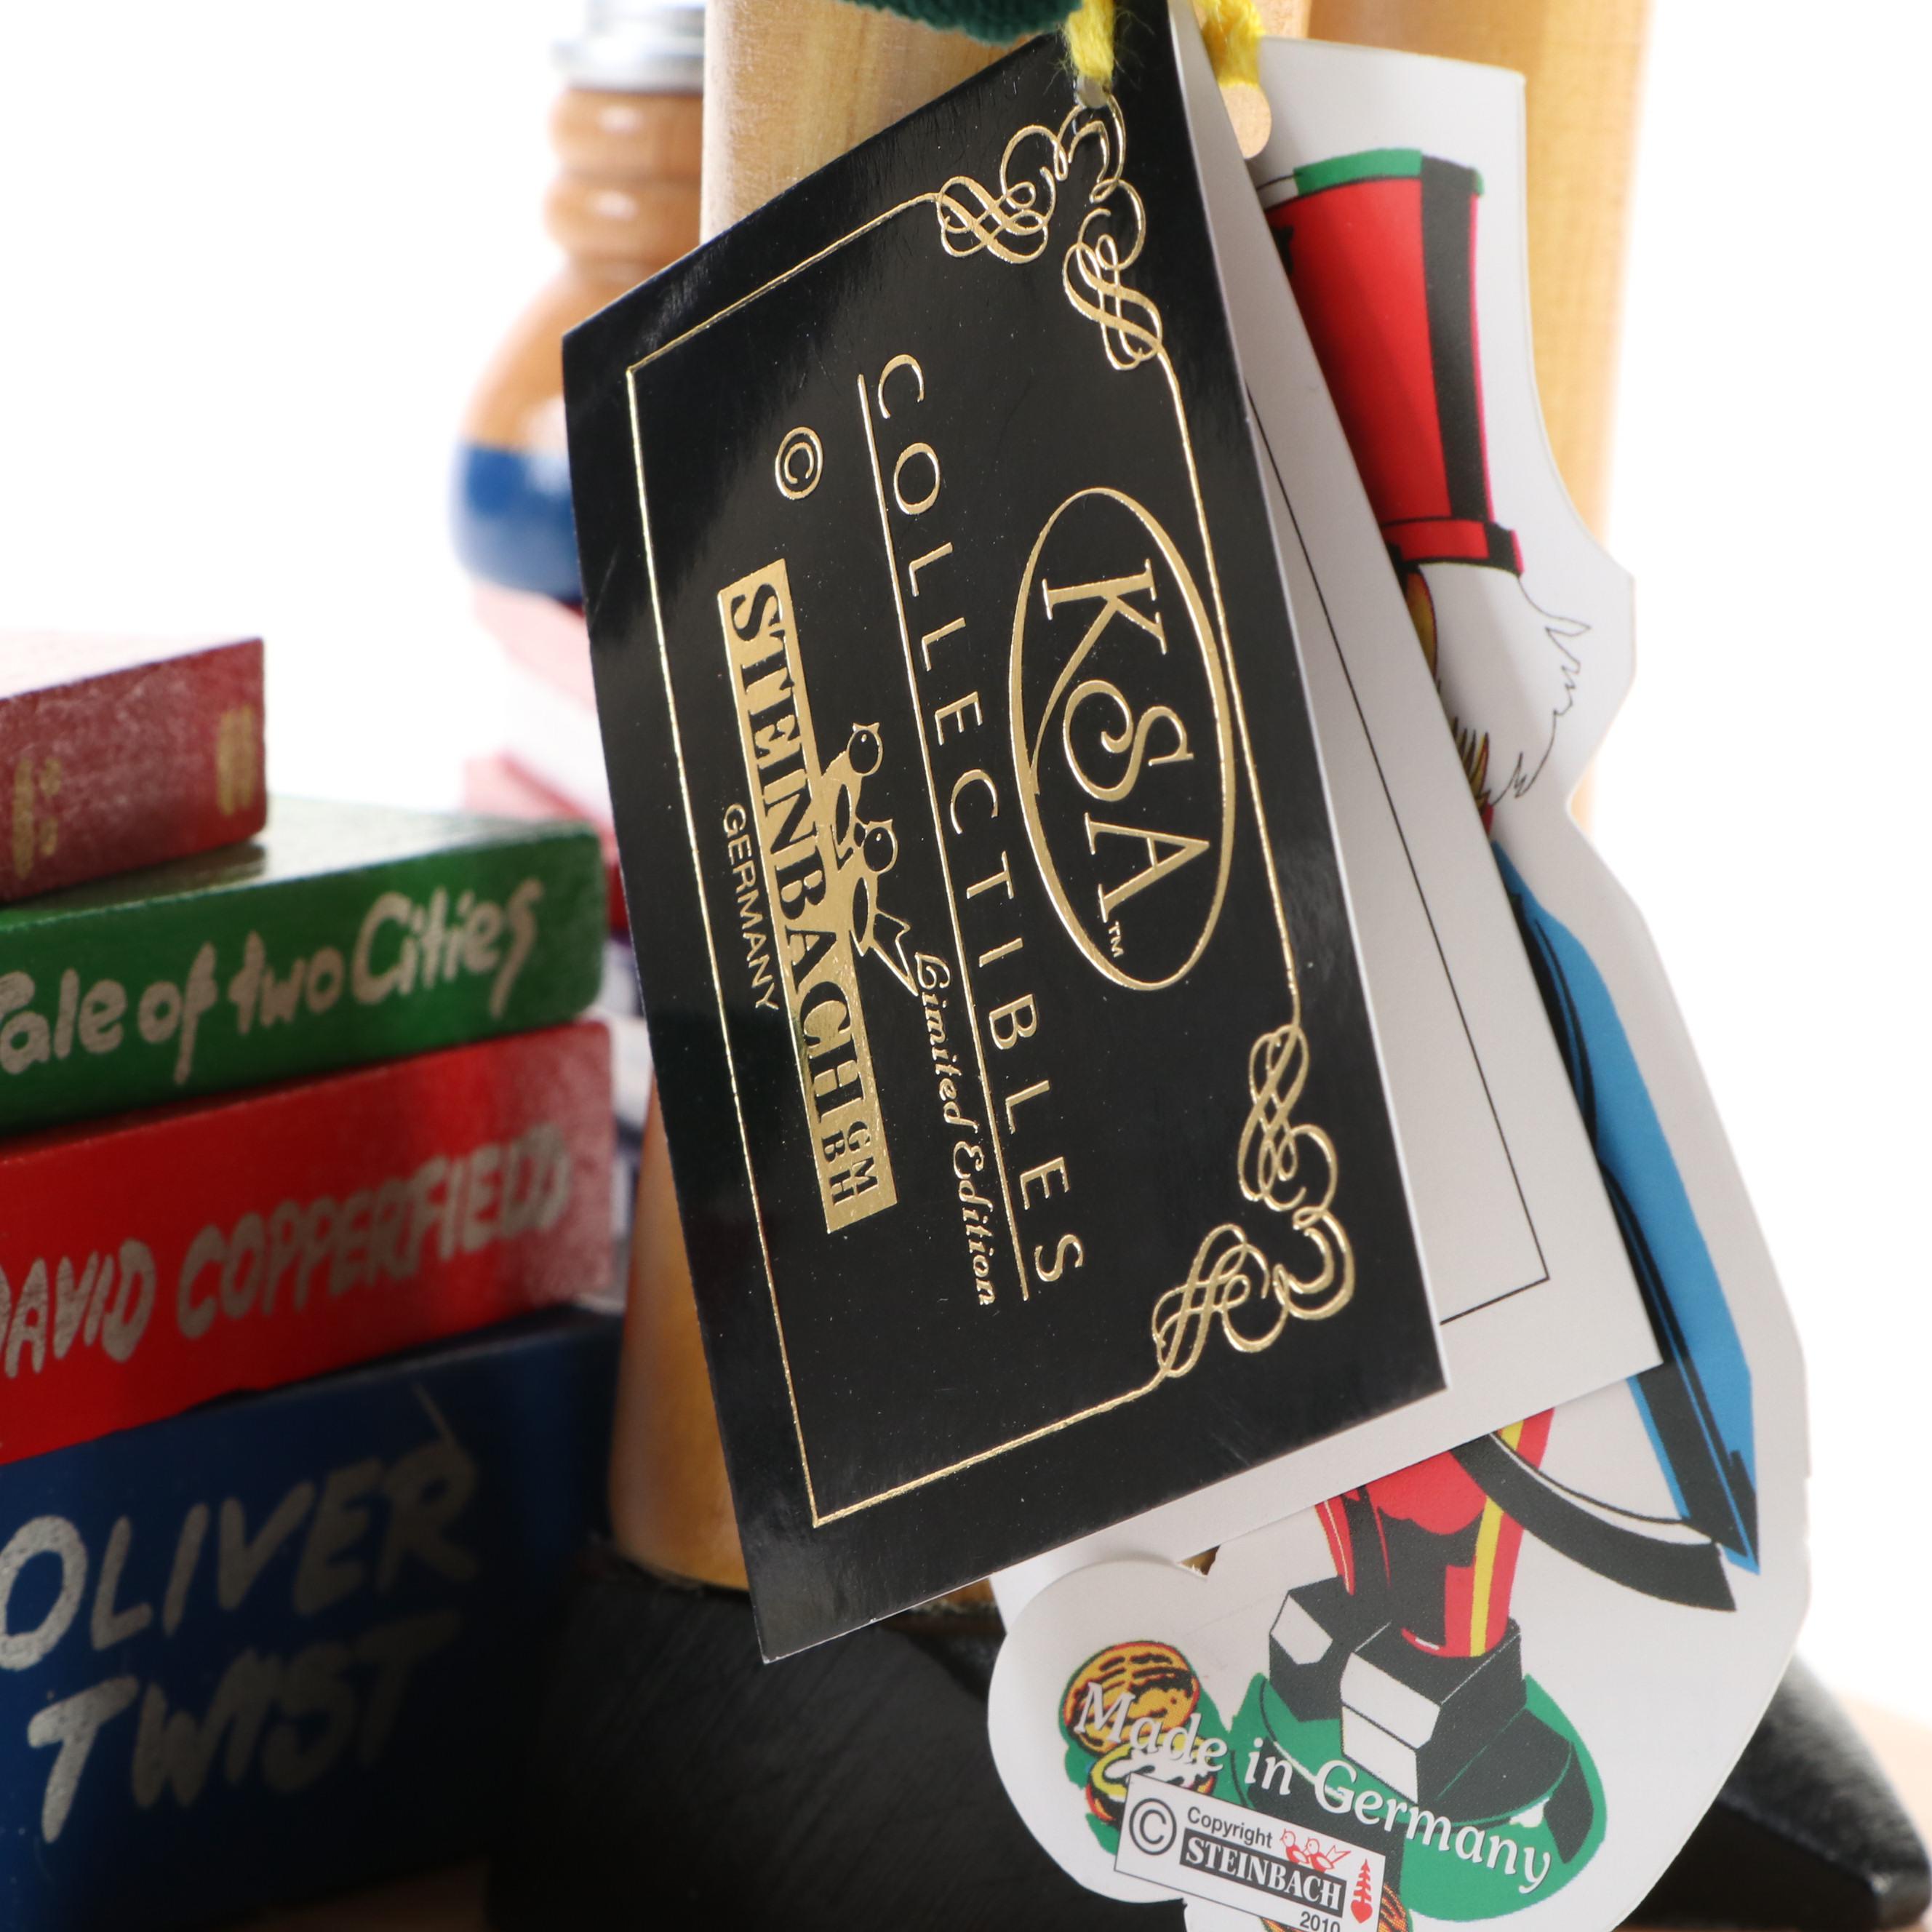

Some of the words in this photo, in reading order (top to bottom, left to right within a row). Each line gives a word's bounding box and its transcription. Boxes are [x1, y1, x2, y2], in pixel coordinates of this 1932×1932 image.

[877, 353, 1084, 1282] COLLECTIBLES
[1031, 559, 1210, 922] KSA
[722, 805, 779, 1010] GERMANY
[729, 582, 866, 1124] STEINBACH
[137, 943, 218, 1086] of
[228, 931, 343, 1034] two
[352, 879, 543, 1018] Cities
[177, 1123, 572, 1340] COPPERFIELD
[914, 951, 978, 1134] Limited
[951, 1140, 996, 1306] Edition
[0, 1445, 481, 1671] OLIVER
[26, 1608, 461, 1845] TWIST
[1075, 1681, 1228, 1775] Made
[1243, 1738, 1293, 1798] in
[1313, 1758, 1553, 1893] Germany
[1186, 1805, 1274, 1851] Copyright
[1185, 1835, 1343, 1912] STEINBACH
[1299, 1910, 1341, 1932] 2010
